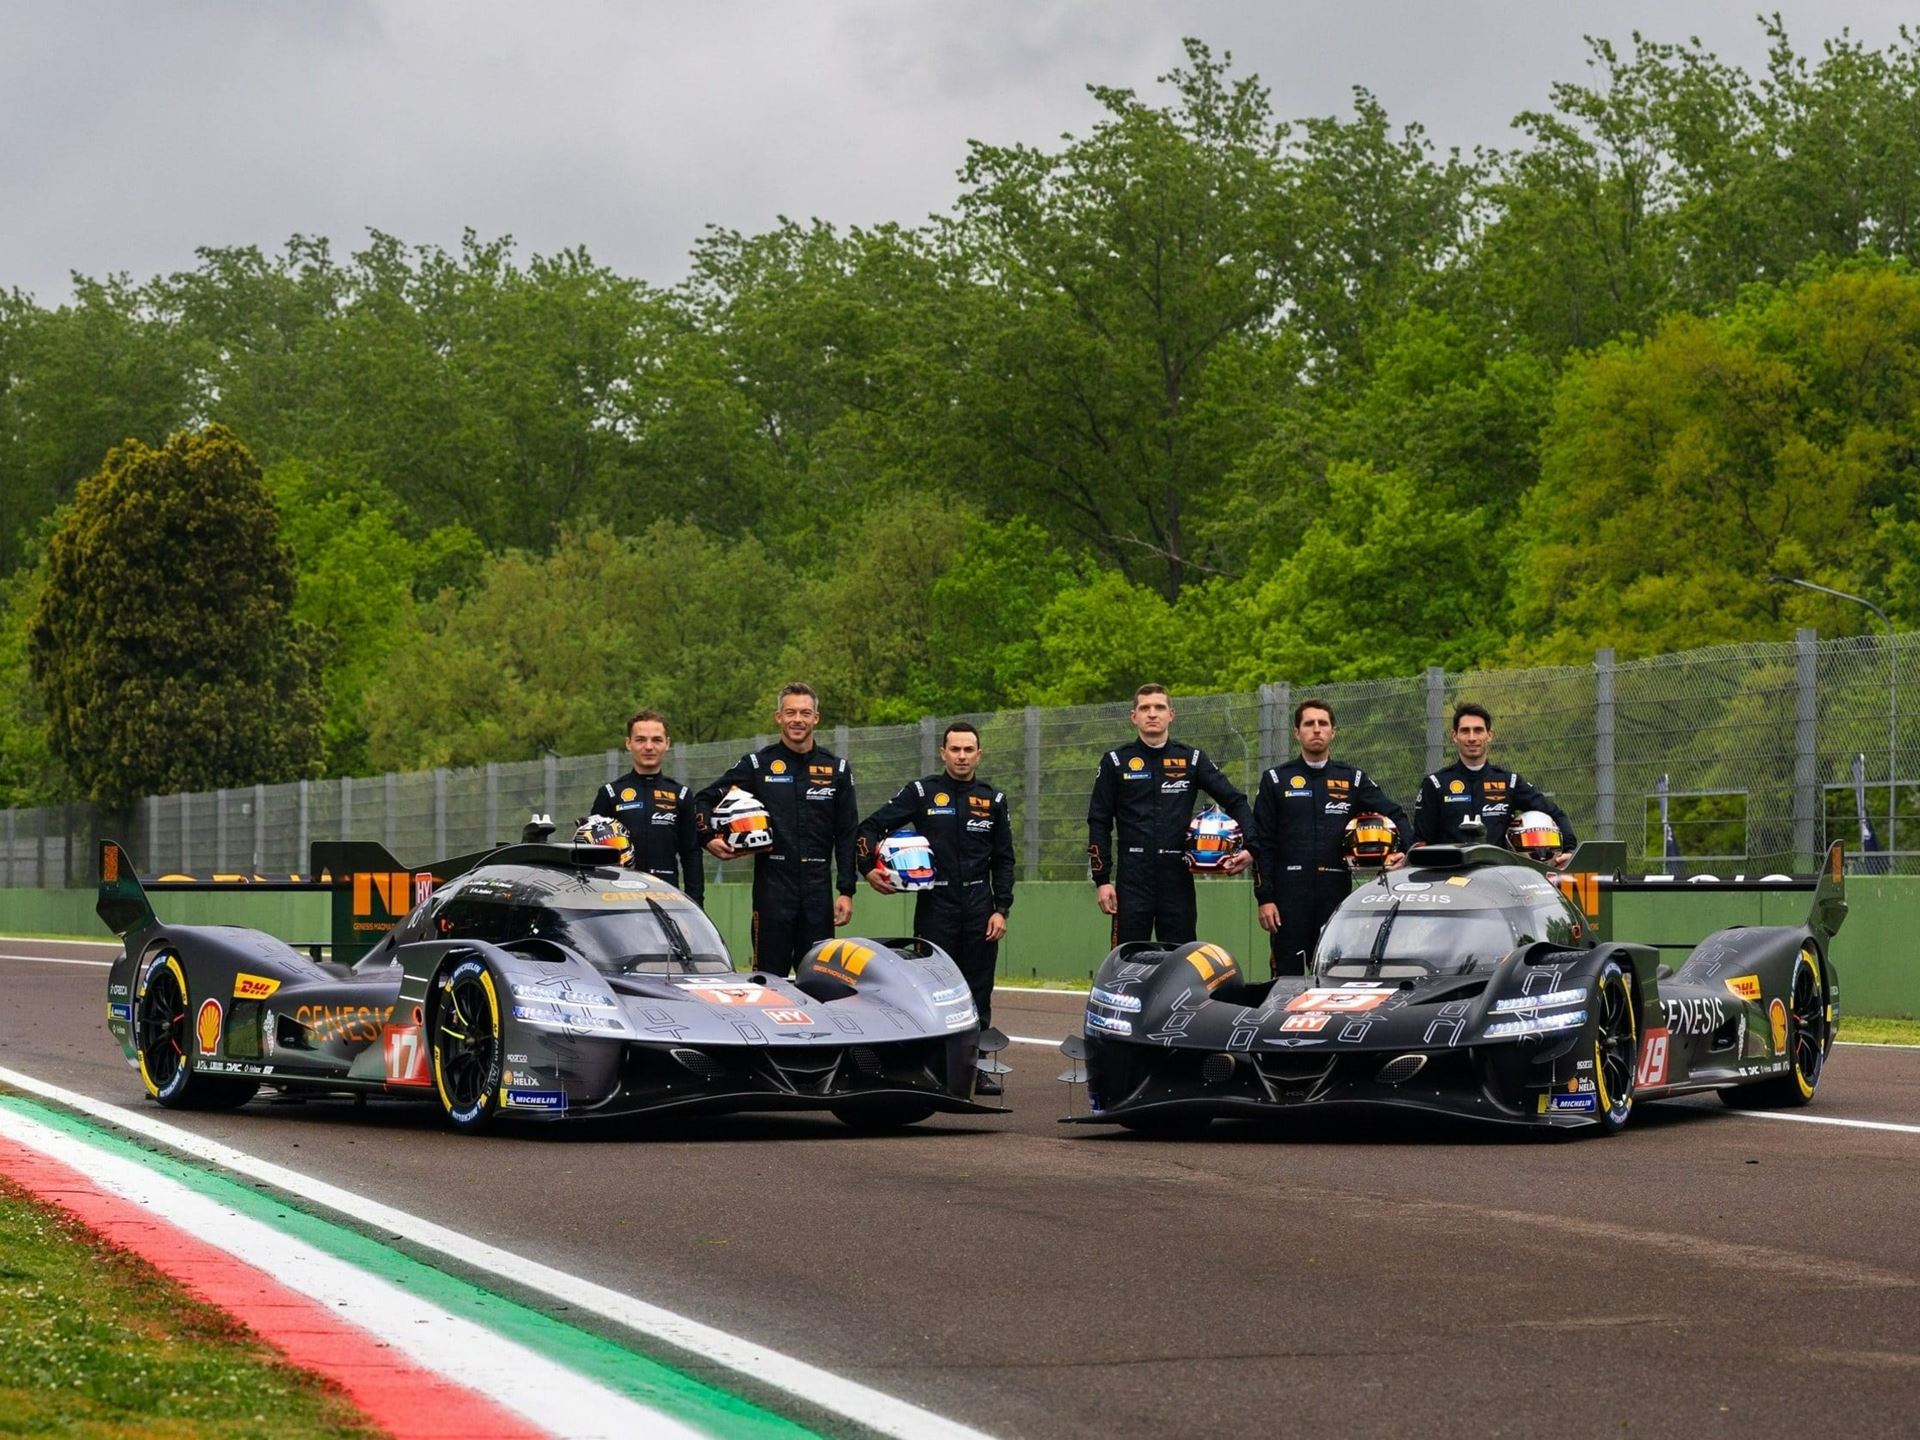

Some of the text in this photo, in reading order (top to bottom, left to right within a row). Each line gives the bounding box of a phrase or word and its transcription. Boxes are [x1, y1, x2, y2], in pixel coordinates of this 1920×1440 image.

[1160, 780, 1190, 789] WEC
[806, 787, 836, 796] WEC
[1325, 802, 1351, 811] WEC
[1482, 803, 1509, 812] WEC
[651, 812, 677, 822] WEC
[966, 819, 994, 829] WEC
[1361, 894, 1451, 904] GENESIS
[240, 980, 270, 995] DHL
[708, 988, 764, 1003] 17
[1299, 993, 1379, 1010] 19
[768, 1011, 803, 1022] HY
[1284, 1016, 1323, 1028] HY
[391, 1033, 418, 1079] 17
[1638, 1036, 1667, 1084] 19
[513, 1076, 540, 1087] HELIX
[515, 1096, 558, 1104] MICHELIN
[1559, 1100, 1592, 1108] MICHELIN
